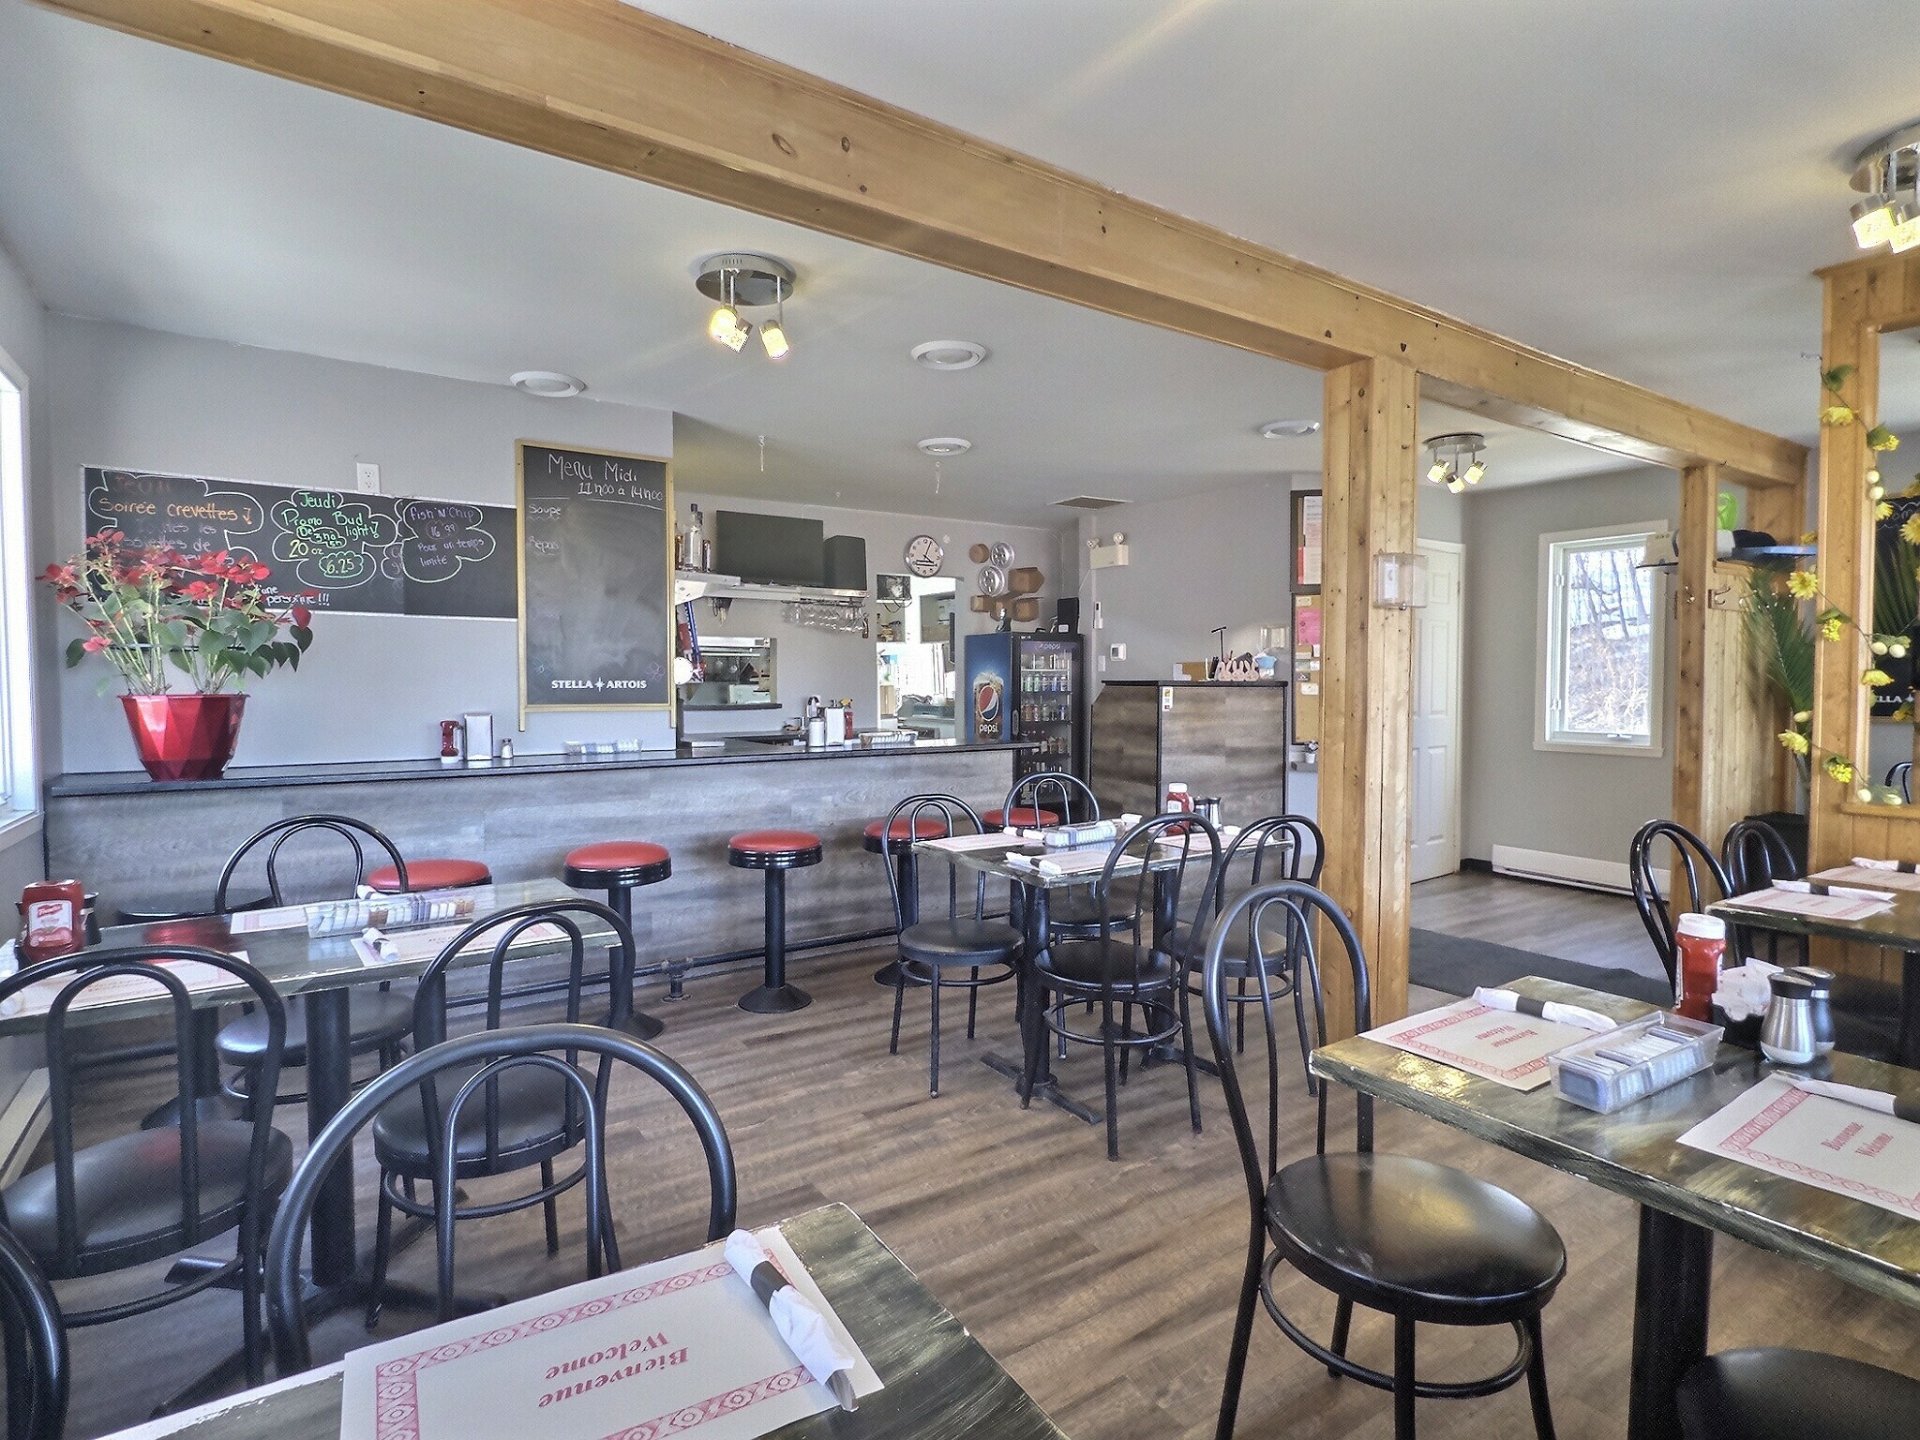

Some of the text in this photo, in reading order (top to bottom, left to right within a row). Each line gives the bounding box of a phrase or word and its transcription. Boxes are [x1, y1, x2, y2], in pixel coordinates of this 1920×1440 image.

[549, 453, 637, 482] Menu Midi
[299, 492, 335, 508] Jeudi
[167, 502, 238, 521] crevettes
[281, 508, 363, 526] Promo Bud
[289, 539, 309, 558] 20
[551, 680, 647, 689] STELLA ARTOIS
[979, 723, 999, 735] pepsi
[1820, 1121, 1864, 1151] Bienvenue
[545, 1332, 670, 1380] Welcome
[538, 1346, 689, 1408] Bienvenue
